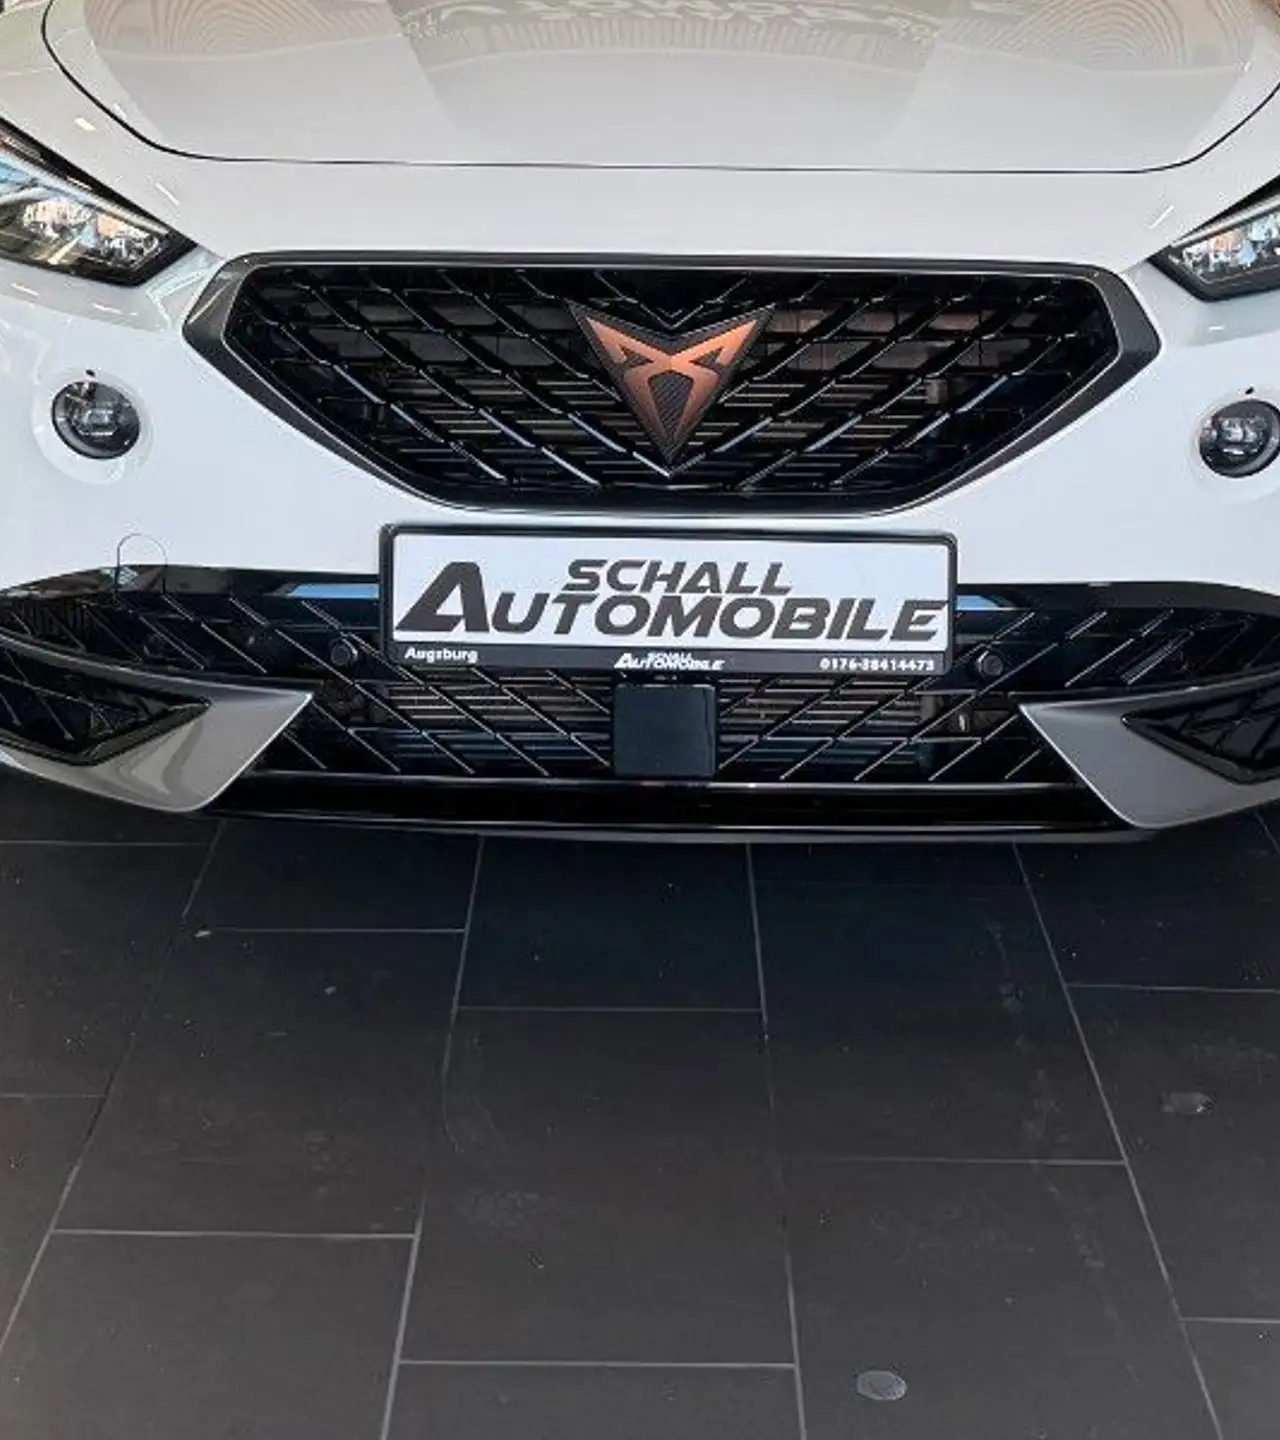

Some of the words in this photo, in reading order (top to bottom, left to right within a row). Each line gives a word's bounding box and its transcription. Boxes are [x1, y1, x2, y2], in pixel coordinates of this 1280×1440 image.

[562, 559, 792, 595] SCHALL
[395, 561, 949, 640] AUTOMOBILE
[404, 647, 478, 663] Augsburg
